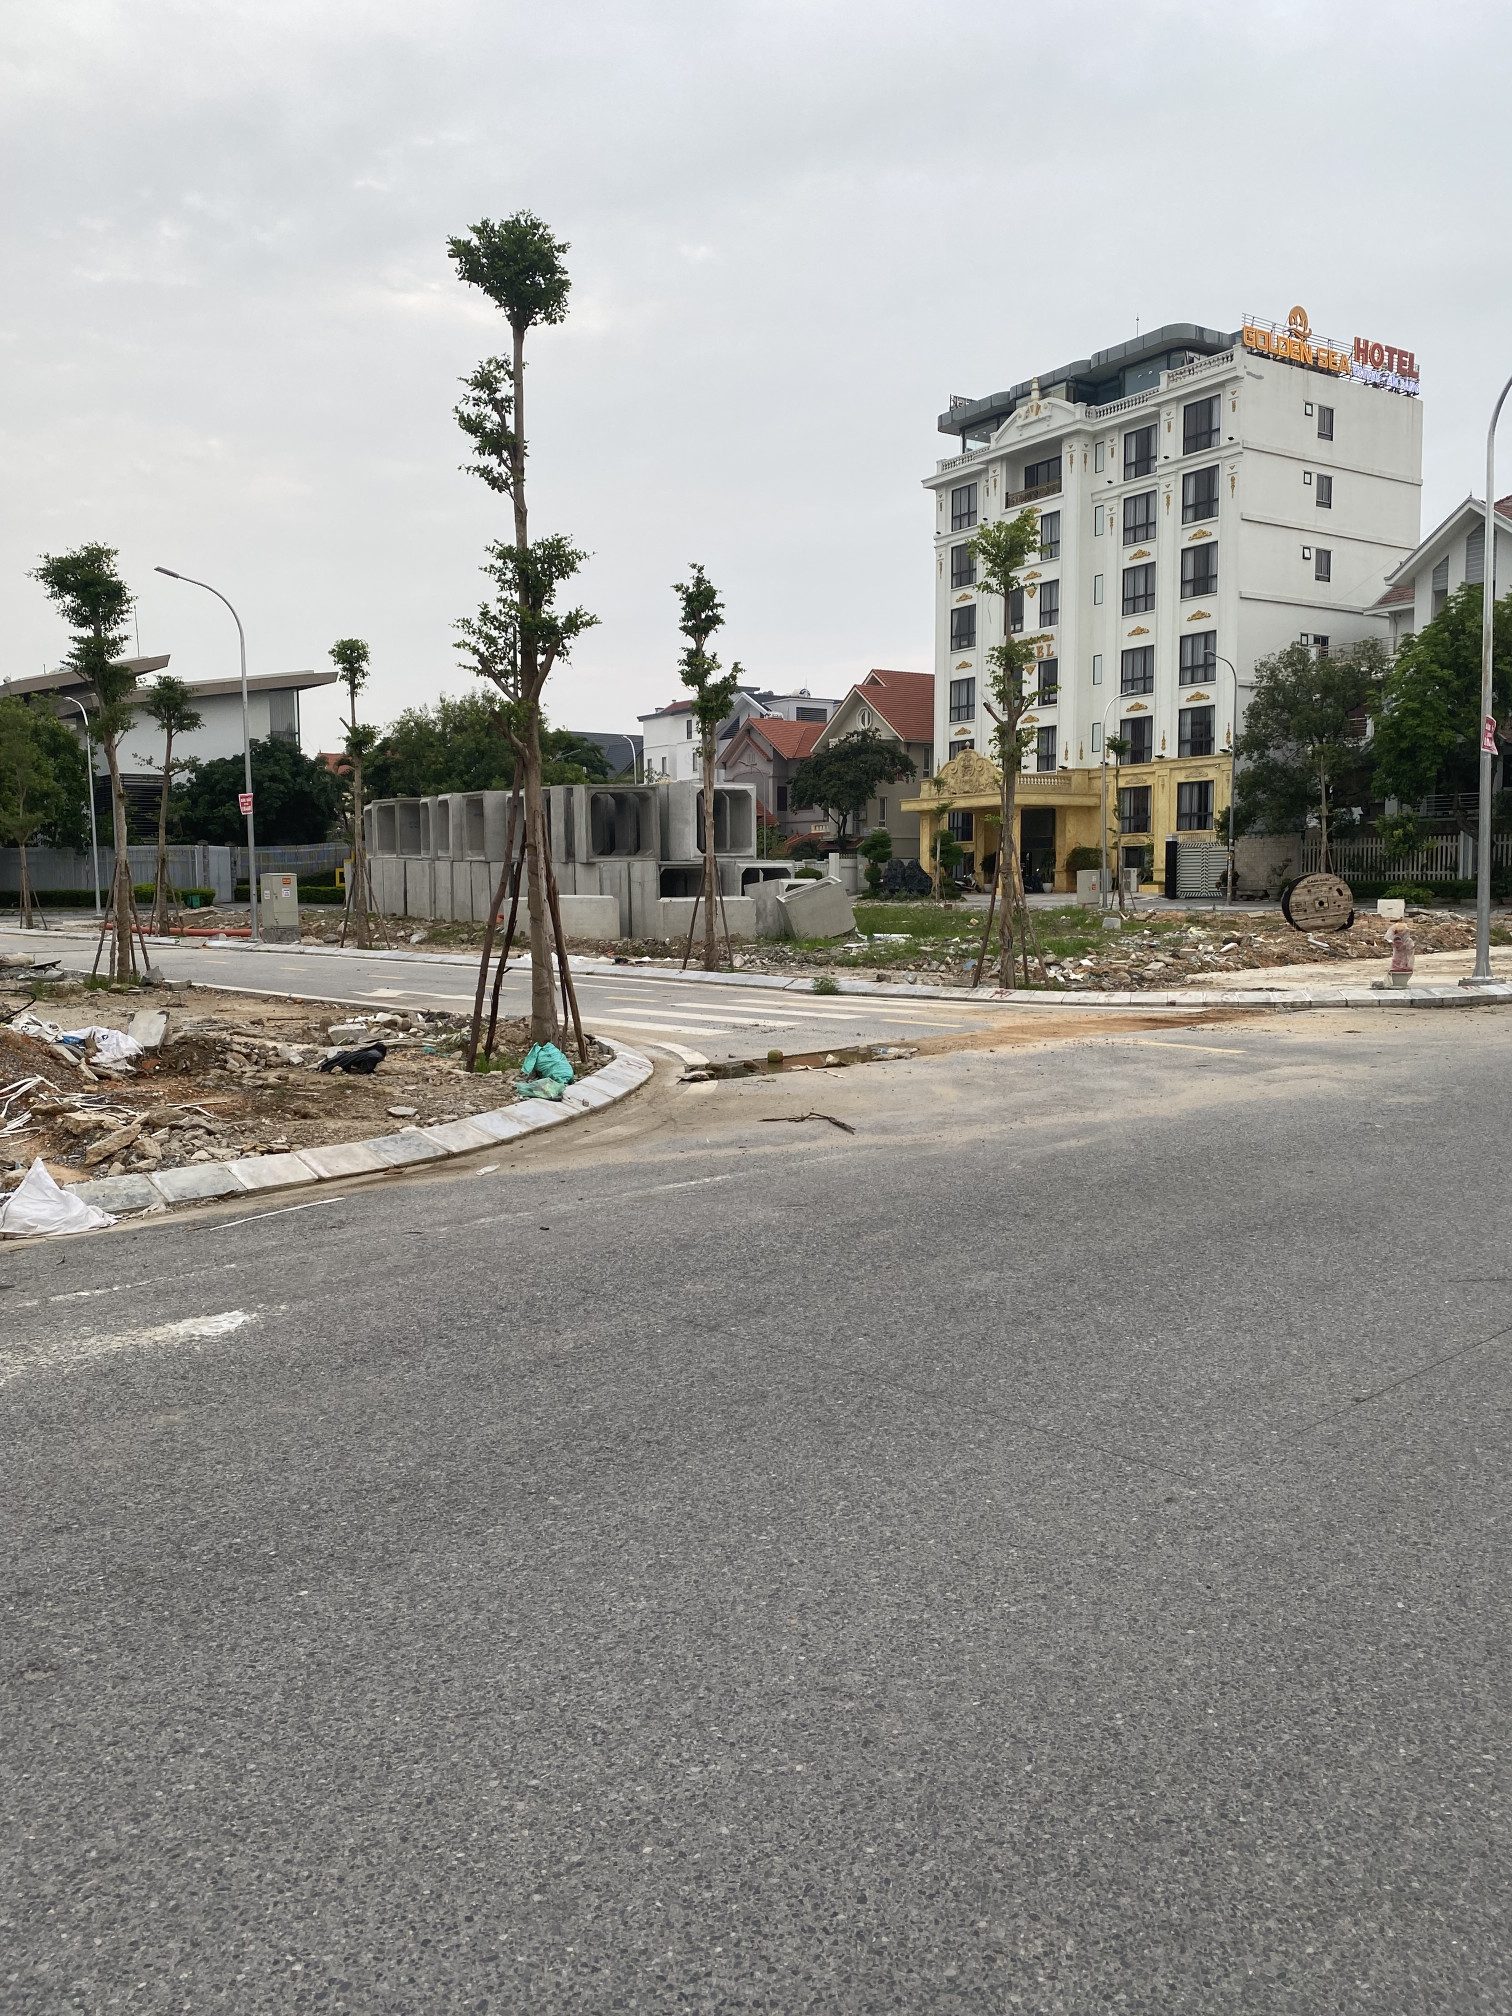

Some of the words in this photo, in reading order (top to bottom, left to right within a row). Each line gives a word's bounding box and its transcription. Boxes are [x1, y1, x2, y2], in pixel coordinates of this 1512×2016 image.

[1243, 325, 1313, 365] GOLDEN
[1317, 347, 1351, 375] SEA
[1354, 336, 1420, 378] HOTEL
